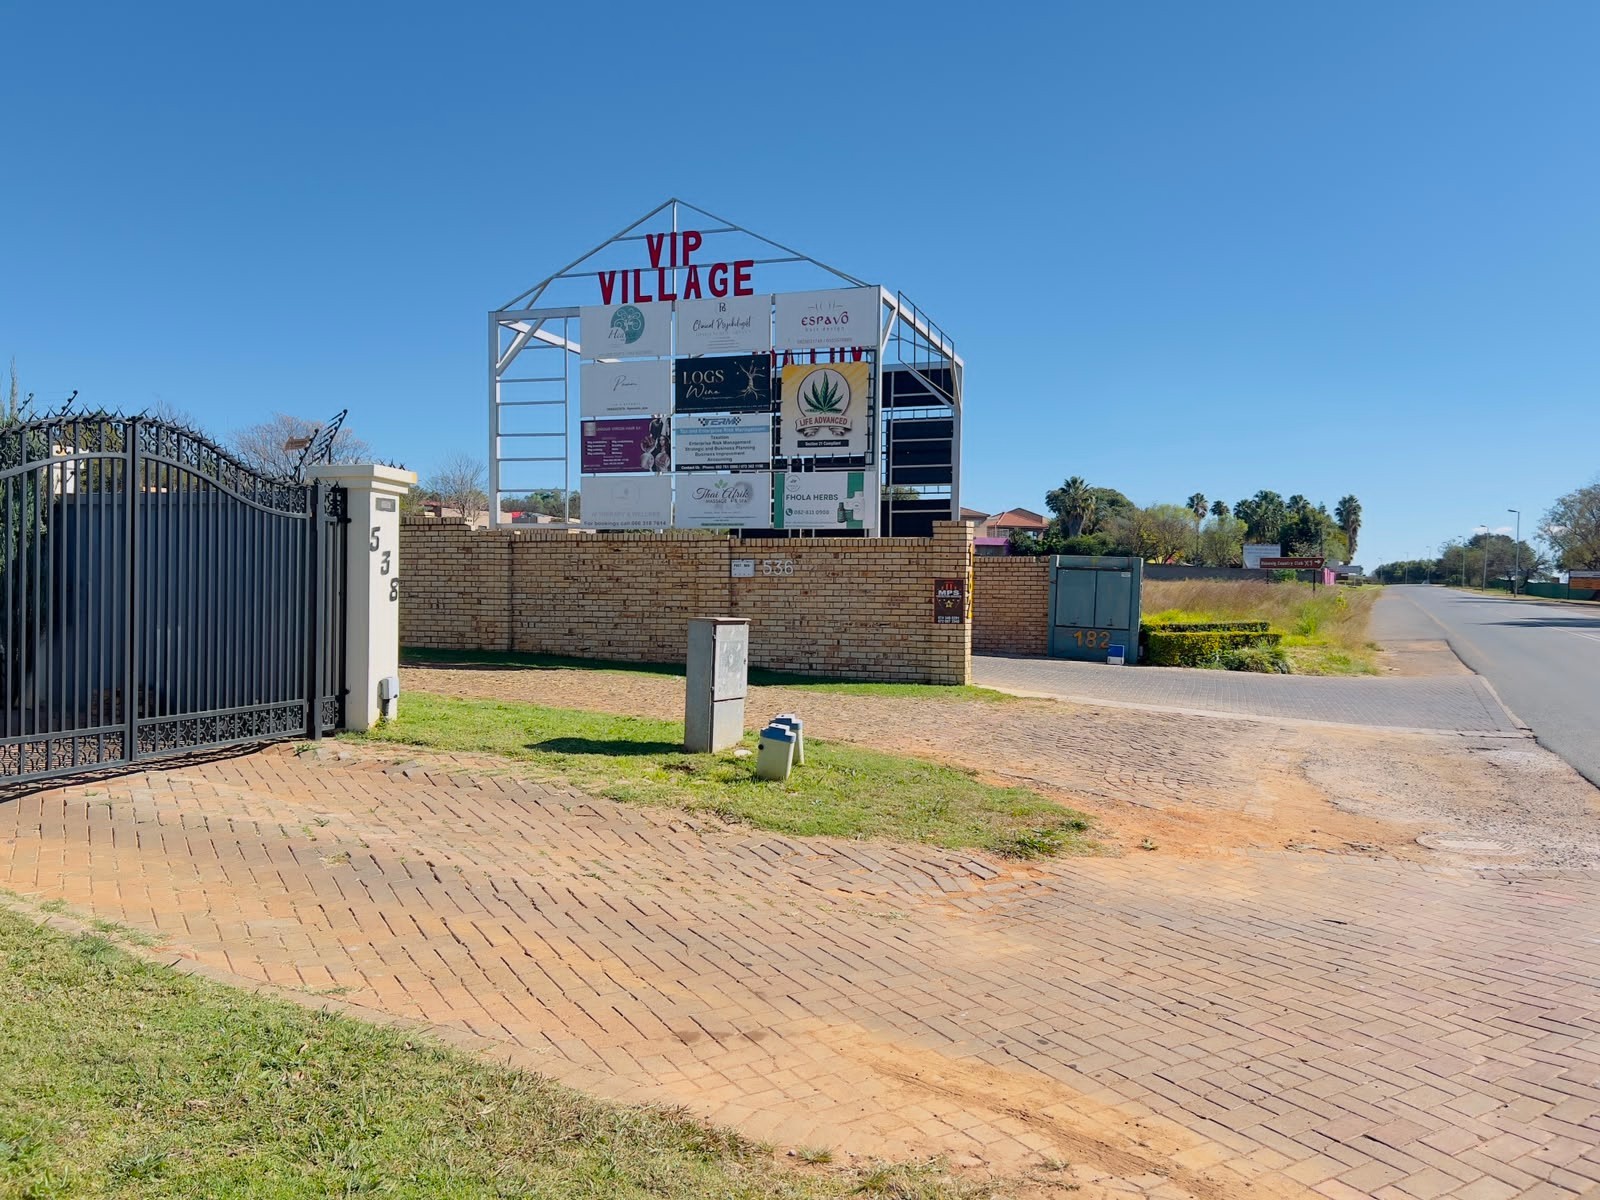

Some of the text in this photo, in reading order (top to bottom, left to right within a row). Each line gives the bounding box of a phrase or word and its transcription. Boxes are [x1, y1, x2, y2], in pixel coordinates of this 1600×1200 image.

[646, 231, 702, 268] VIP
[598, 260, 754, 305] VILLAGE
[683, 370, 724, 384] LOGS
[800, 416, 847, 427] LIFE ADVANCED
[692, 486, 750, 504] Thai Afrik
[763, 560, 794, 574] 536
[1074, 630, 1109, 648] 182
